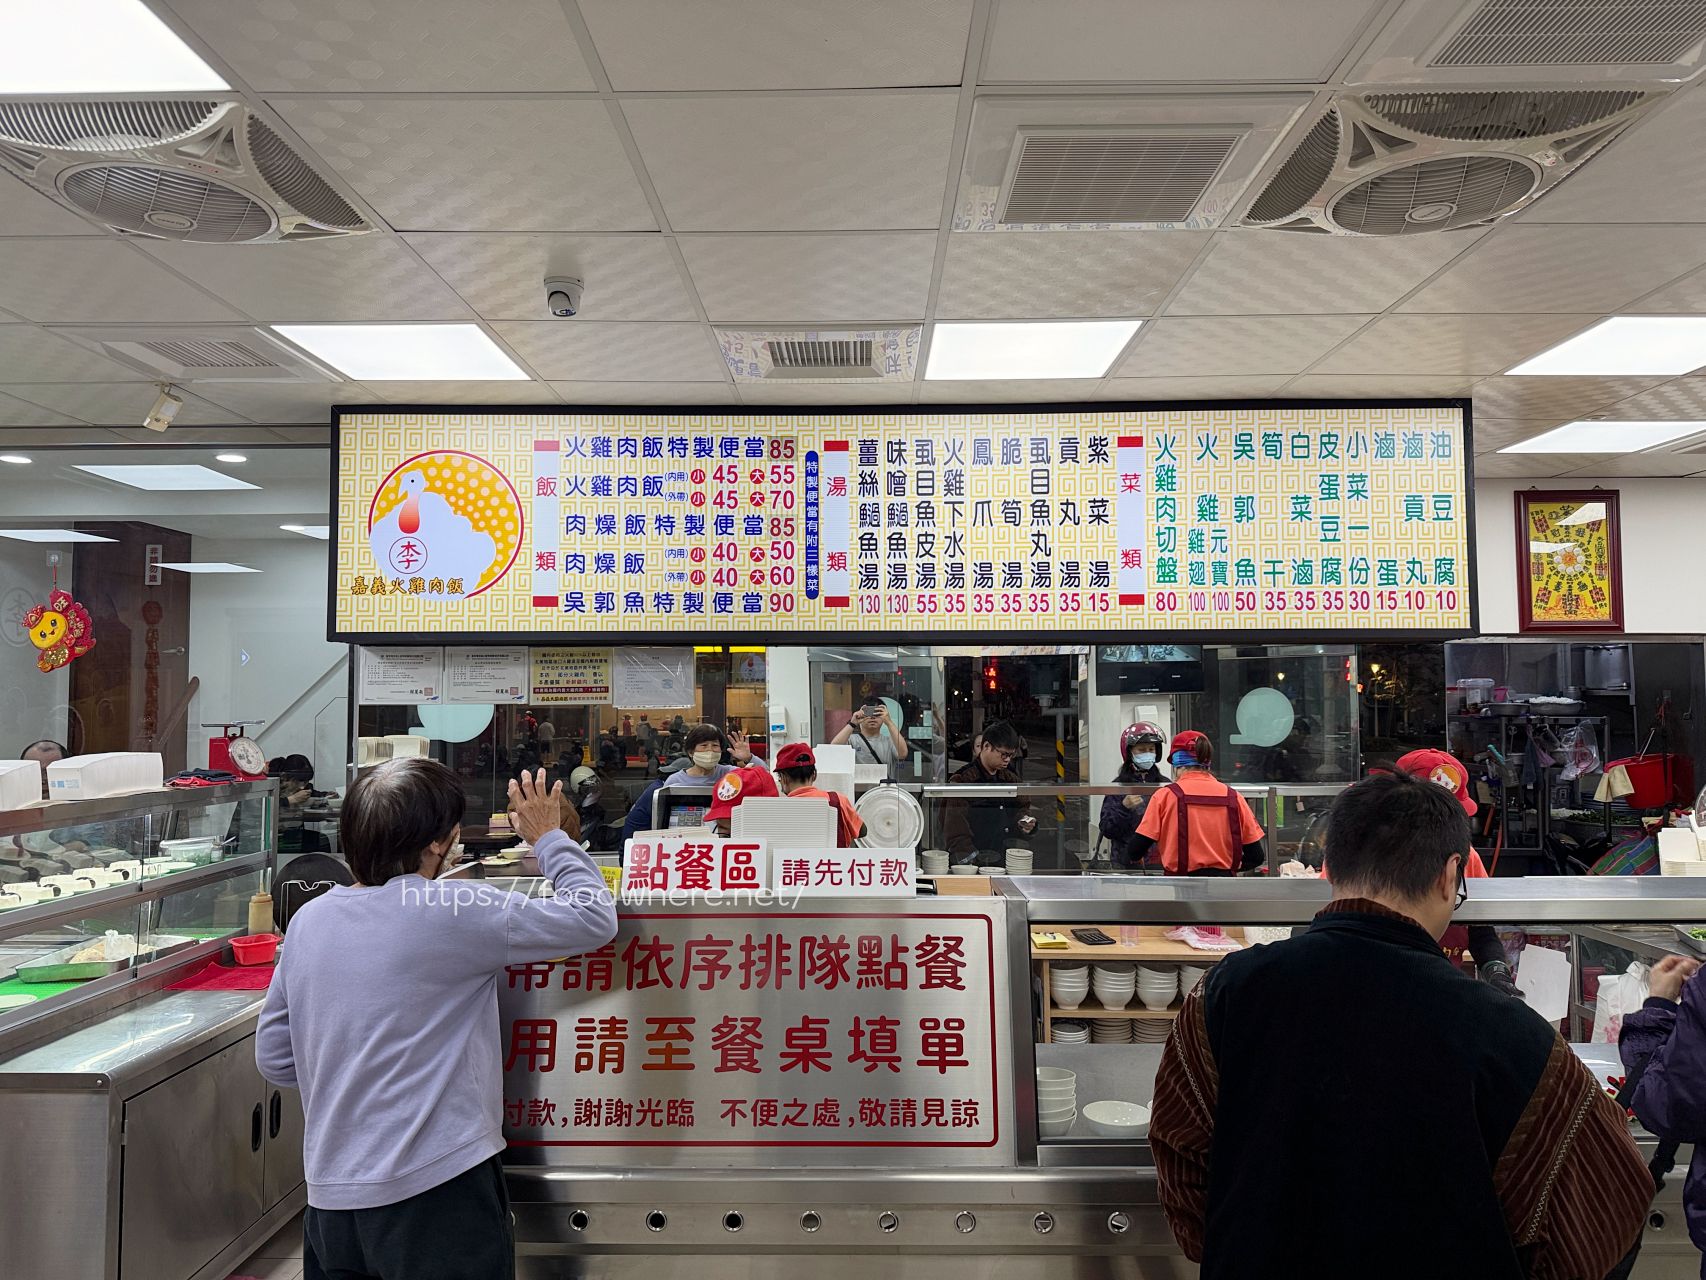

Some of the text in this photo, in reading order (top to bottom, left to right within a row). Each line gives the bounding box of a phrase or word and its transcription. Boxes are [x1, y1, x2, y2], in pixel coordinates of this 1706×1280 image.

[565, 436, 795, 459] 火雞肉飯特製便當 85
[712, 465, 738, 484] 45
[769, 465, 795, 484] 55
[565, 475, 664, 497] 火雞肉飯
[712, 490, 738, 509] 45
[769, 490, 795, 509] 70
[565, 514, 795, 537] 肉燥飯特製便當 85
[806, 461, 819, 591] 特製便當有附三樣菜
[943, 440, 966, 613] 火雞下水湯 35
[1155, 434, 1178, 612] 火雞肉切盤 80
[712, 542, 738, 562] 40
[769, 541, 795, 561] 50
[565, 553, 645, 574] 肉燥飯
[351, 576, 465, 596] 嘉義火雞肉飯
[712, 568, 738, 587] 40
[769, 566, 795, 586] 60
[564, 592, 795, 614] 吳郭魚特製便當 90
[858, 595, 881, 614] 130
[887, 595, 909, 614] 130
[916, 594, 937, 613] 55
[973, 594, 994, 613] 35
[1001, 594, 1022, 613] 35
[1028, 593, 1050, 613] 35
[1059, 593, 1081, 613] 35
[1089, 593, 1110, 612] 15
[1188, 591, 1206, 612] 100
[1211, 591, 1230, 612] 100
[1235, 591, 1256, 612] 50
[1264, 591, 1287, 612] 35
[1293, 591, 1316, 611] 35
[1322, 591, 1344, 611] 35
[1349, 590, 1370, 611] 30
[1376, 590, 1398, 611] 15
[1404, 590, 1425, 611] 10
[1435, 590, 1457, 611] 10
[627, 842, 760, 890] 點餐區
[782, 858, 909, 887] 請先付款
[505, 1015, 970, 1074] 用請至餐桌填單
